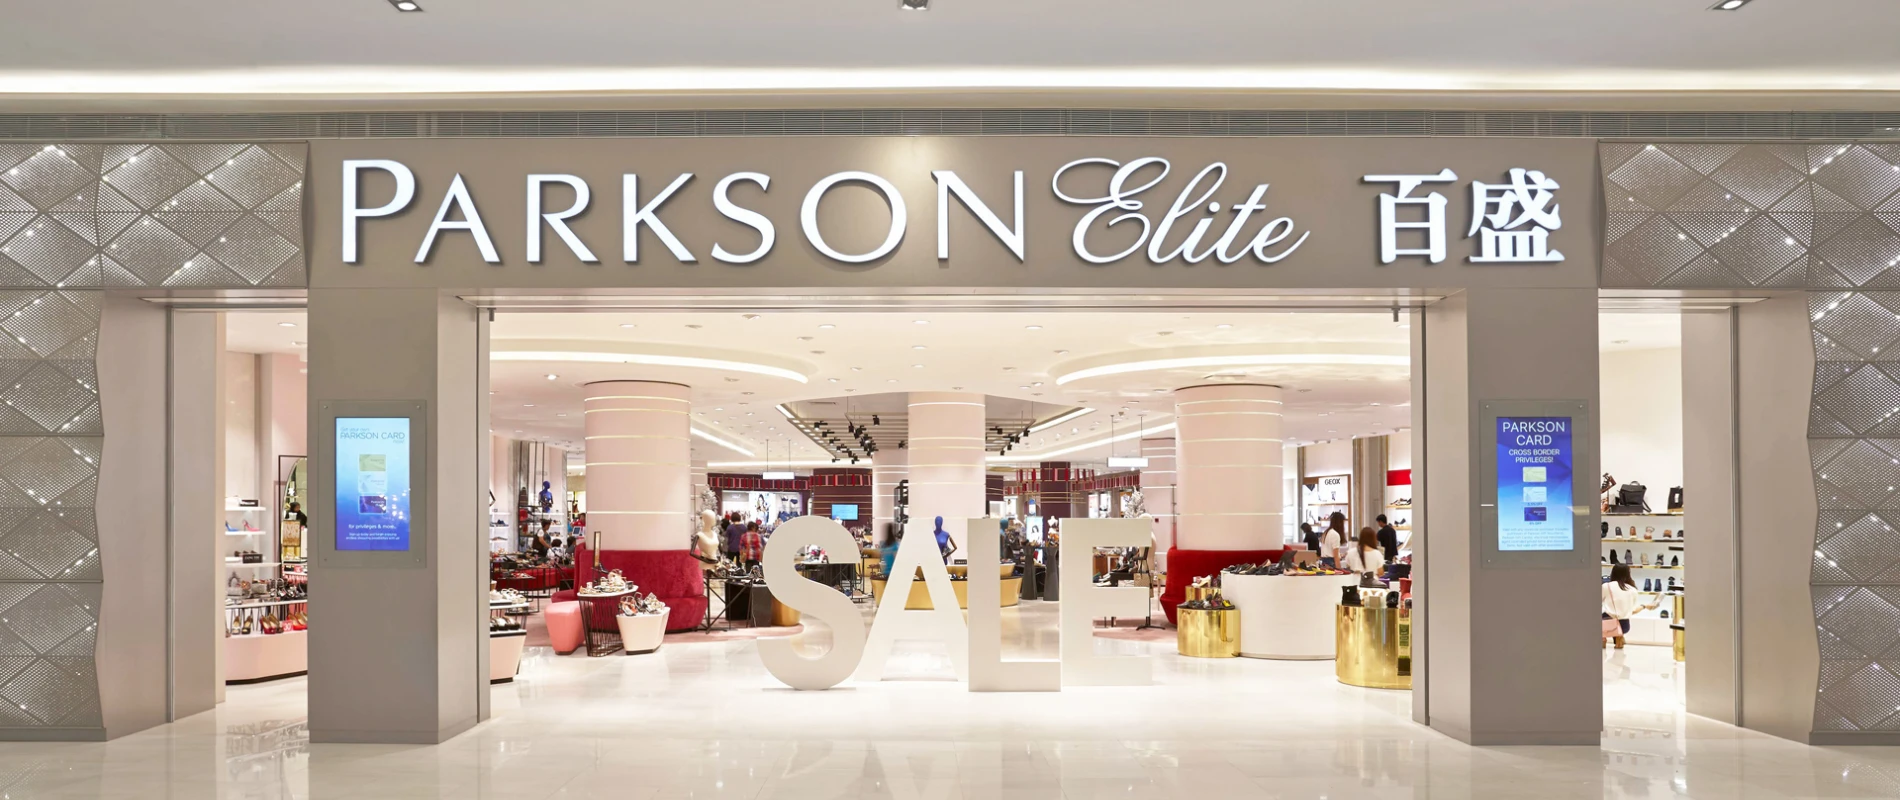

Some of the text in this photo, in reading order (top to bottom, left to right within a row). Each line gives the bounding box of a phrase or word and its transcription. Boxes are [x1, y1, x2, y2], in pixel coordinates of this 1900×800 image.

[342, 156, 1310, 265] PARKSON Elite
[1362, 167, 1566, 265] 百盛
[1502, 421, 1566, 433] PARKSON
[340, 432, 406, 440] PARKSON CARD
[1516, 434, 1553, 446] CARD
[1508, 448, 1560, 456] CROSS BORDER
[756, 514, 1153, 692] SALE
